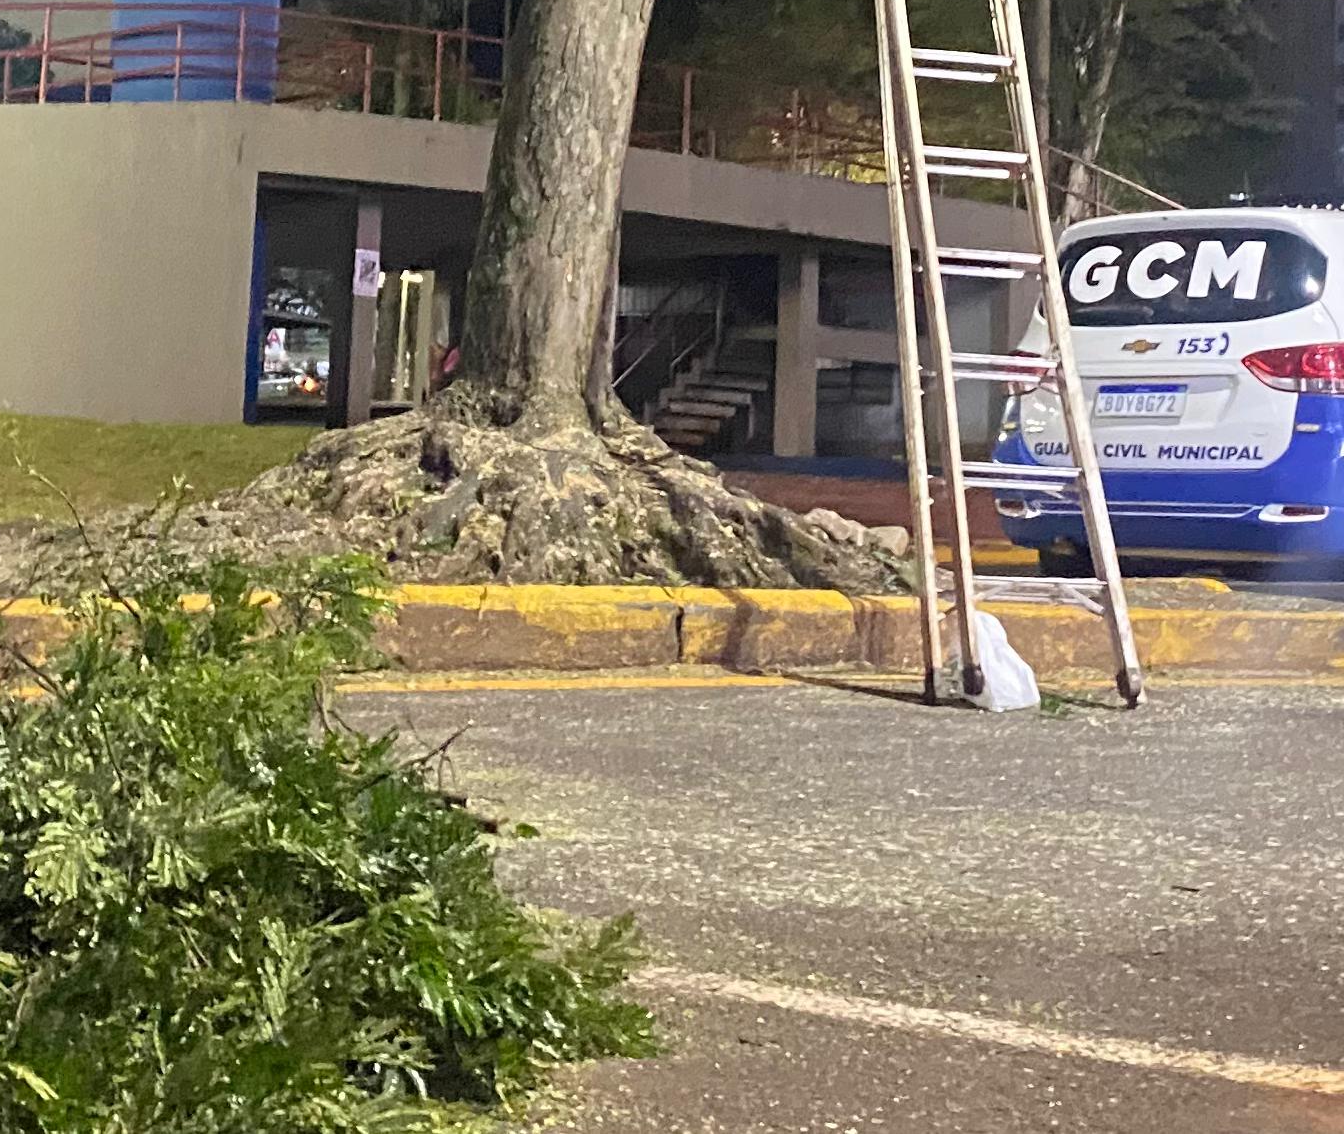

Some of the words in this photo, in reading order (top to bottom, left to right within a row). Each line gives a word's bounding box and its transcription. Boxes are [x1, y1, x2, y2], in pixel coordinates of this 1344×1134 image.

[1069, 241, 1267, 303] GCM
[1177, 338, 1217, 354] 153
[1034, 442, 1098, 458] GUA
[1103, 443, 1147, 459] CIVIL
[1157, 445, 1264, 461] MUNICIPAL
